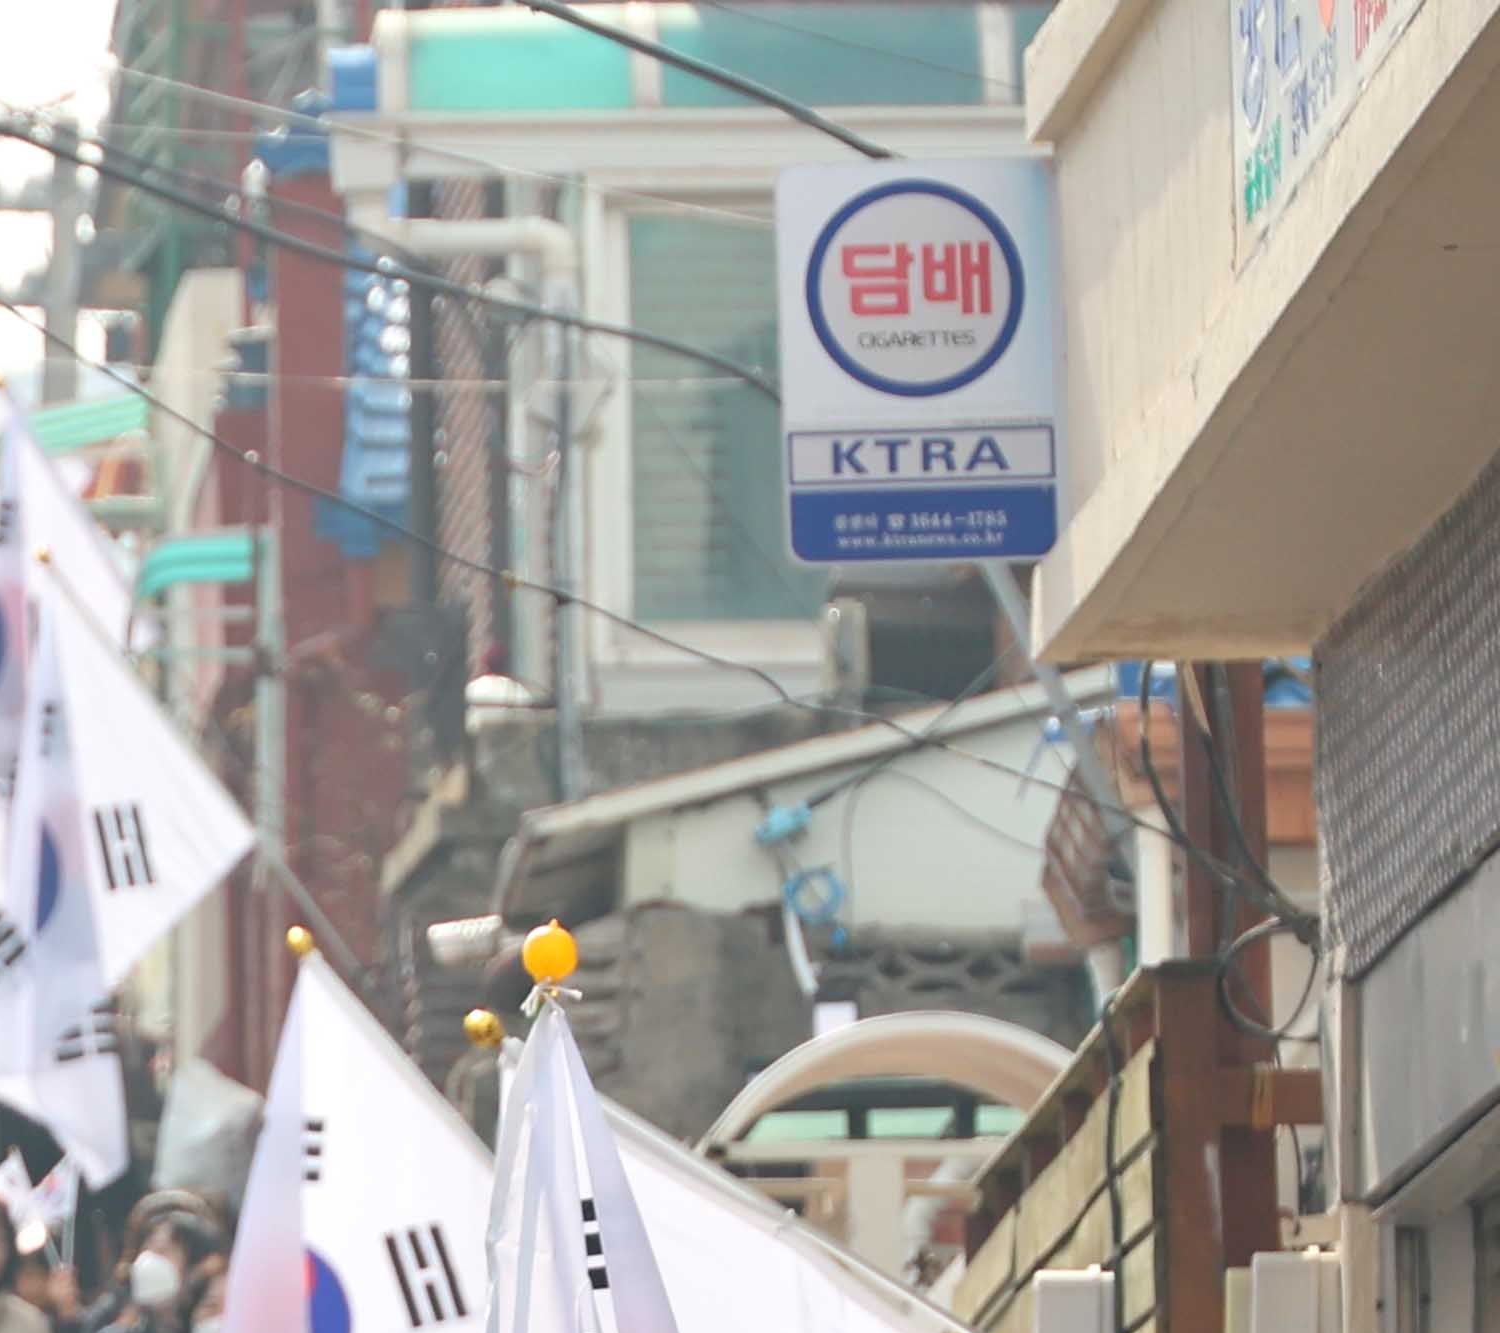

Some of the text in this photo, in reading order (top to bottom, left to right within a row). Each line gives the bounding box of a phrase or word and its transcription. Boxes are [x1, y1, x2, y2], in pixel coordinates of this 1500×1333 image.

[841, 240, 993, 317] 담배
[857, 329, 978, 350] CIGARETTES
[831, 435, 1010, 475] KTRA
